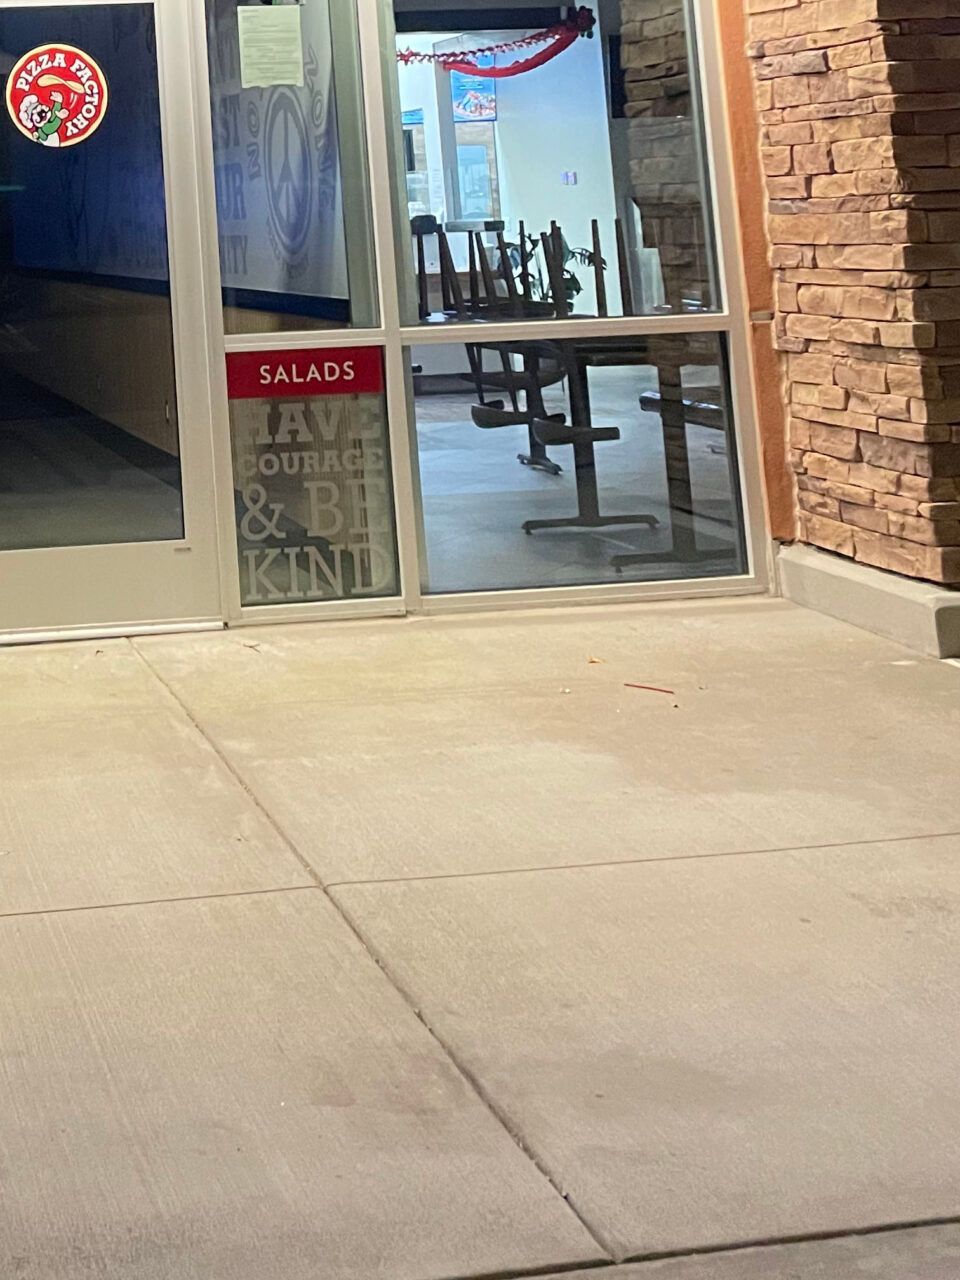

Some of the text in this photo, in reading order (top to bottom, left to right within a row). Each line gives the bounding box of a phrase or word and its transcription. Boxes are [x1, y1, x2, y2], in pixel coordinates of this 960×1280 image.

[15, 53, 100, 137] PIZZA FACTORY
[259, 361, 355, 384] SALADS
[234, 401, 381, 445] HAVE
[239, 448, 384, 477] COURAGE
[240, 478, 388, 541] & BE
[243, 543, 392, 601] KIND
